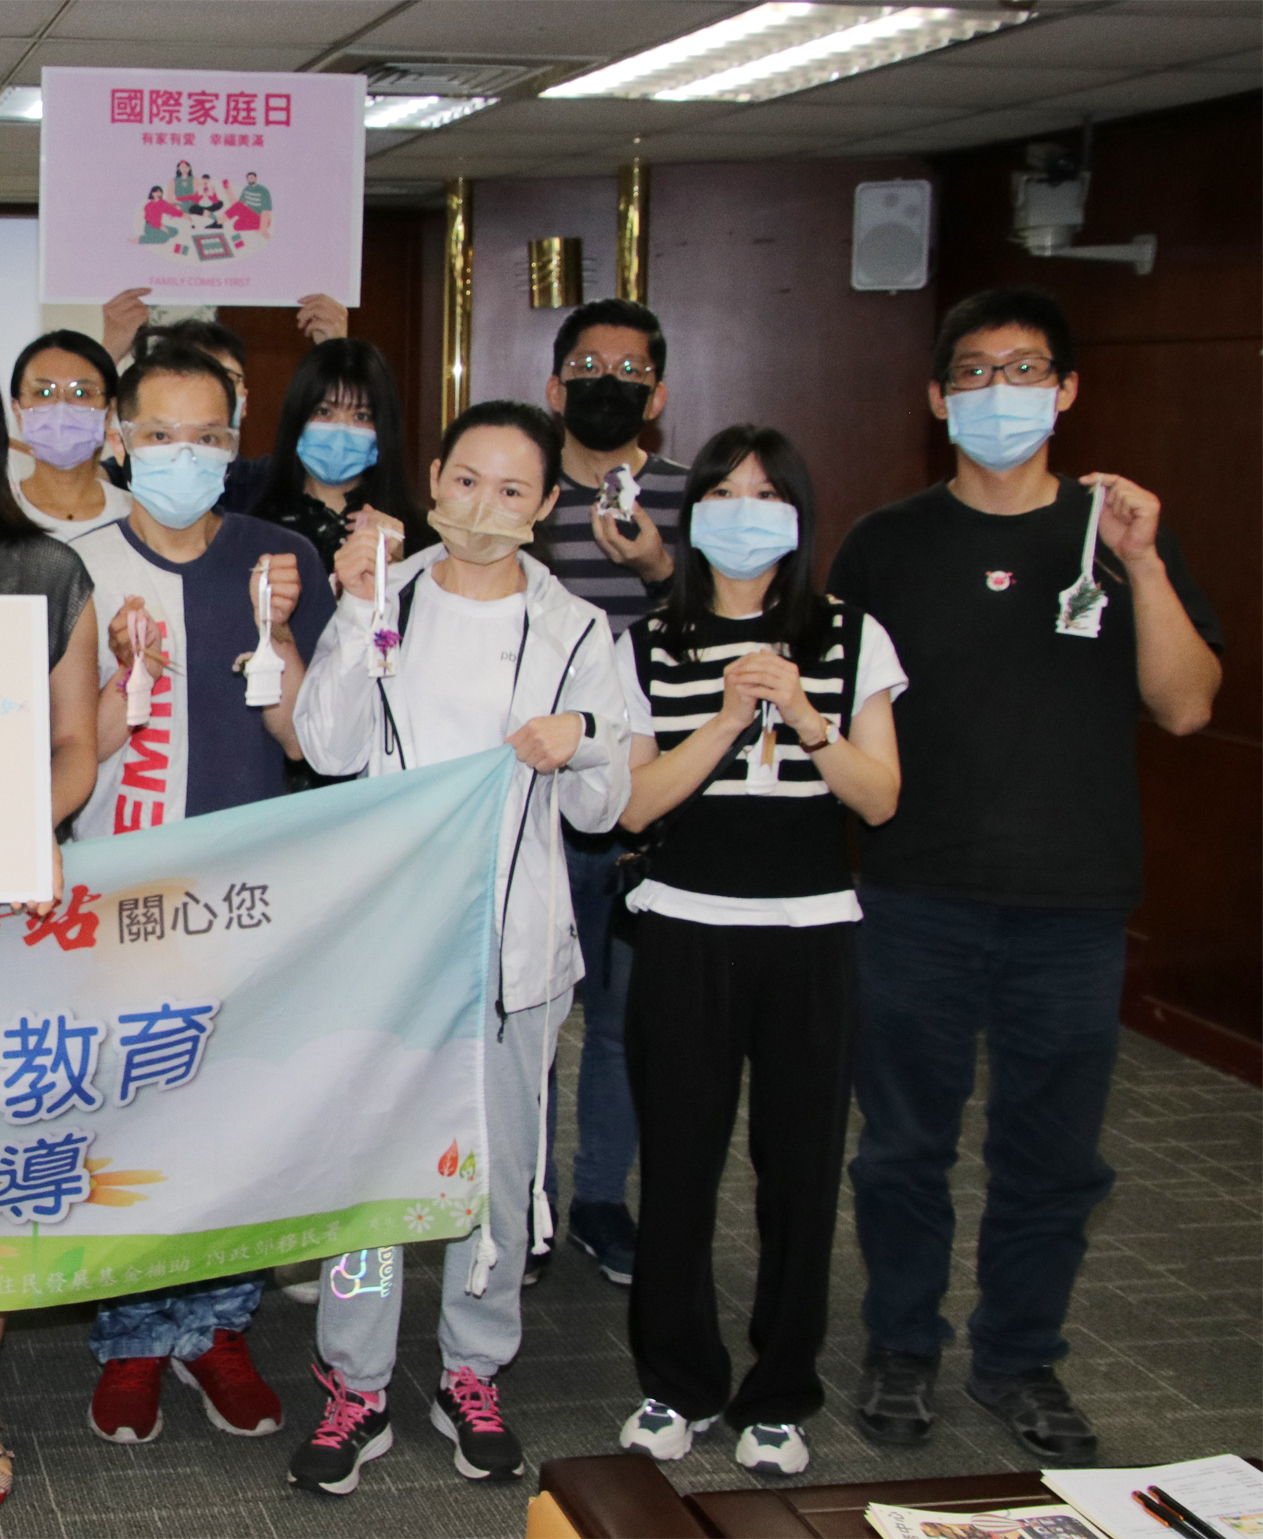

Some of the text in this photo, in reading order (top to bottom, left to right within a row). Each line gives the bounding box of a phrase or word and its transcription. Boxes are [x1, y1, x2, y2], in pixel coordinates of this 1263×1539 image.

[110, 88, 292, 128] 國際家庭日
[210, 133, 265, 148] 幸福美滿
[149, 276, 186, 287] FAMILY
[118, 882, 272, 944] 關心您
